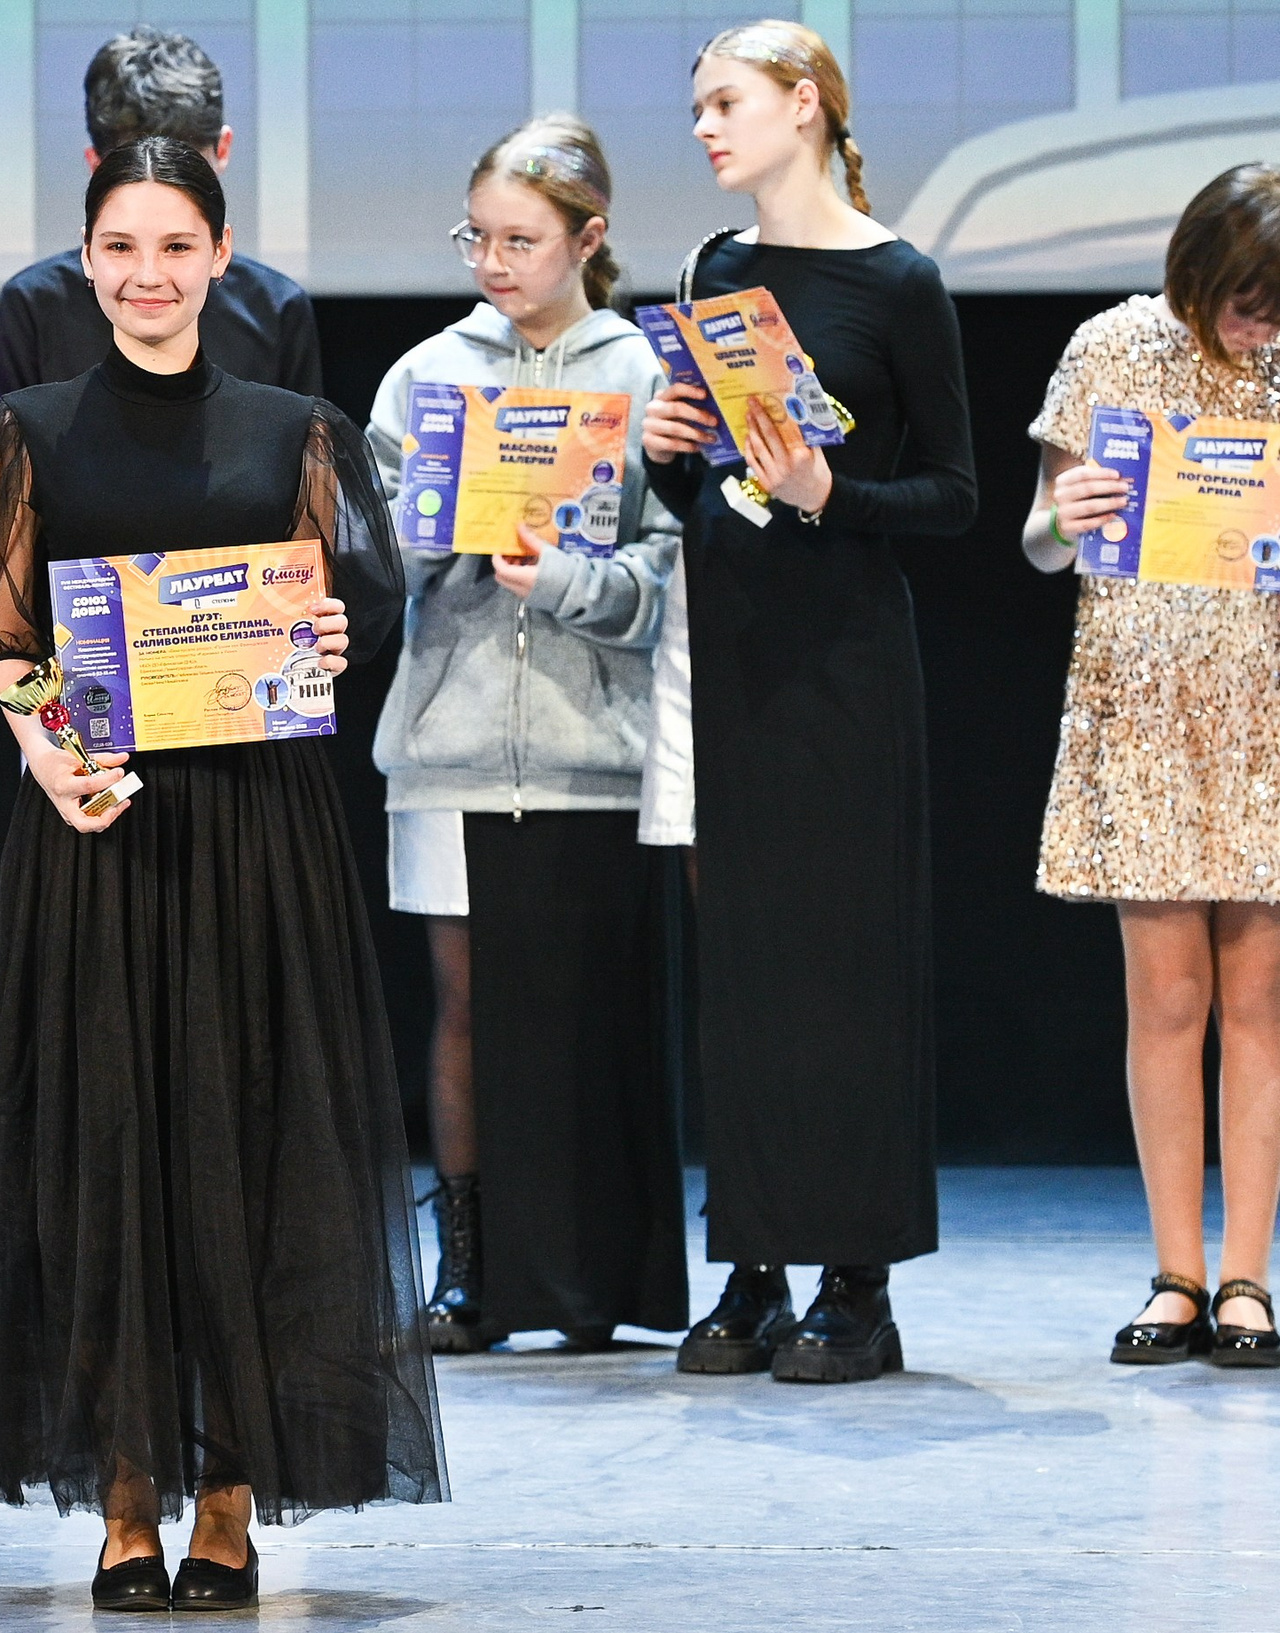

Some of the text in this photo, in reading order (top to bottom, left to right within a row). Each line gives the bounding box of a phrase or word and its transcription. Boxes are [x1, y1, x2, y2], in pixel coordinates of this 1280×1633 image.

[504, 410, 568, 424] ЛАУРЕАТ
[499, 442, 558, 454] МАСЛОВА
[1194, 441, 1264, 456] ЛАУРЕАТ
[500, 455, 555, 465] ВАЛЕРИЯ
[1177, 471, 1266, 488] ПОГОРЕЛОВА
[1197, 486, 1242, 498] АРИНА
[170, 569, 245, 595] ЛАУРЕАТ
[73, 596, 107, 607] СОЮЗ
[71, 605, 111, 618] ДОБРА
[191, 612, 223, 623] ДУЭТ:
[142, 619, 273, 637] СТЕПАНОВА СВЕТЛАНА,
[133, 633, 218, 649] СИЛИВОНЕНКО
[220, 628, 284, 642] ЕЛИЗАВЕТА
